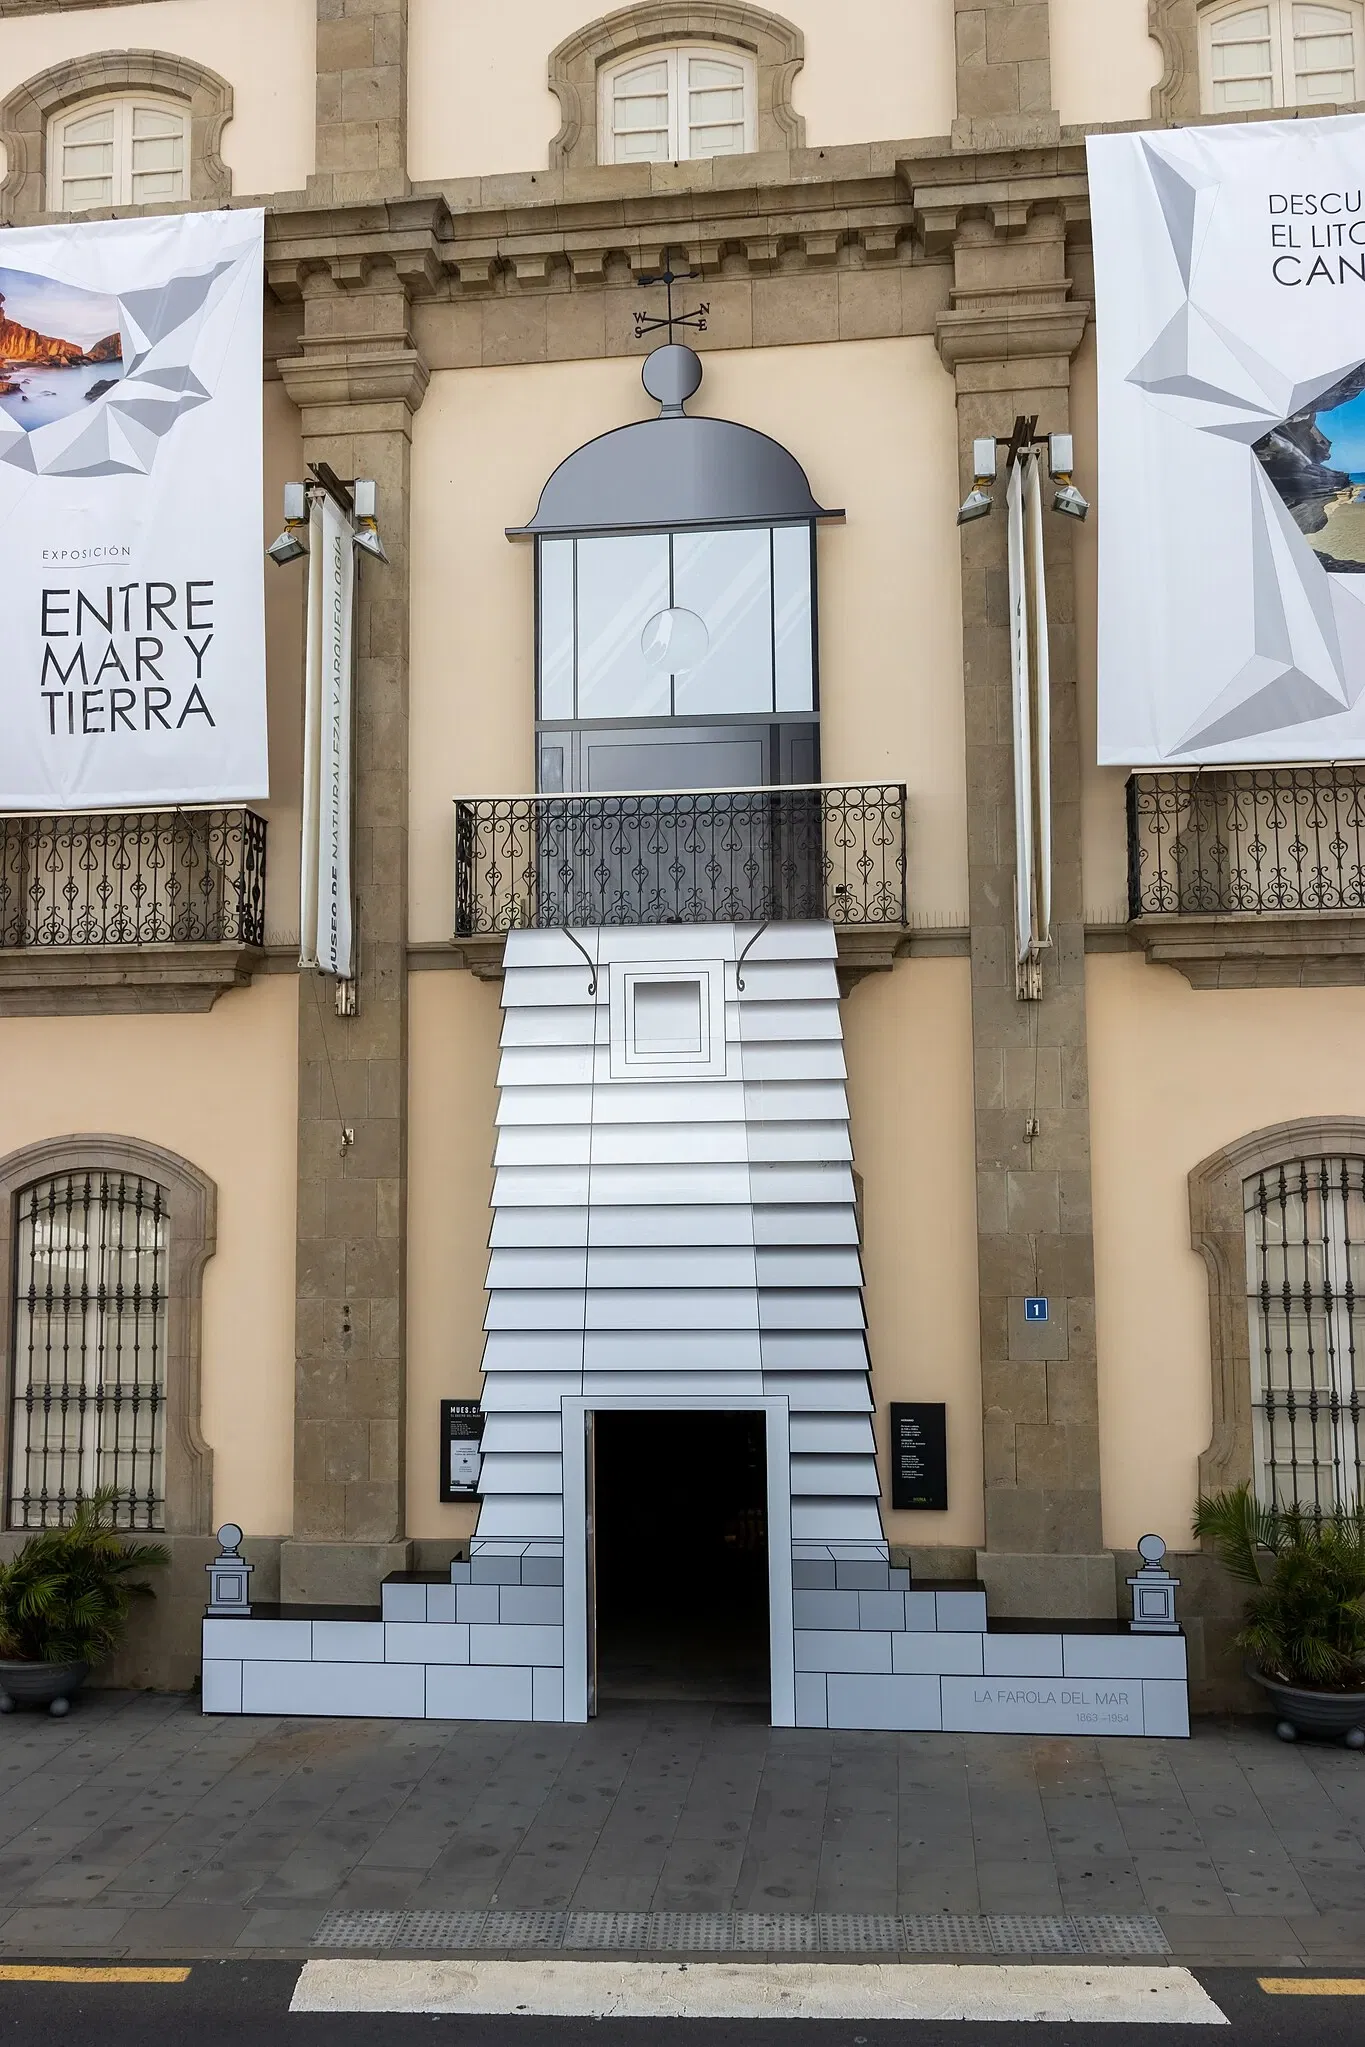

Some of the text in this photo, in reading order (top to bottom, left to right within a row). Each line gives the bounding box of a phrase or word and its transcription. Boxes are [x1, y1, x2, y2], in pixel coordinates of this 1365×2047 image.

[1269, 189, 1362, 216] DESCU
[1271, 224, 1302, 249] EL
[699, 303, 711, 316] N
[632, 311, 646, 324] W
[698, 319, 708, 331] E
[634, 327, 643, 339] S
[42, 545, 131, 560] EXPOSICIÓN
[41, 580, 214, 637] ENTRE
[40, 633, 214, 686] MAR Y
[40, 682, 216, 735] TIERRA
[331, 865, 338, 897] DE
[1033, 1304, 1039, 1316] 1
[973, 1690, 1129, 1705] LA FAROLA DEL MAR
